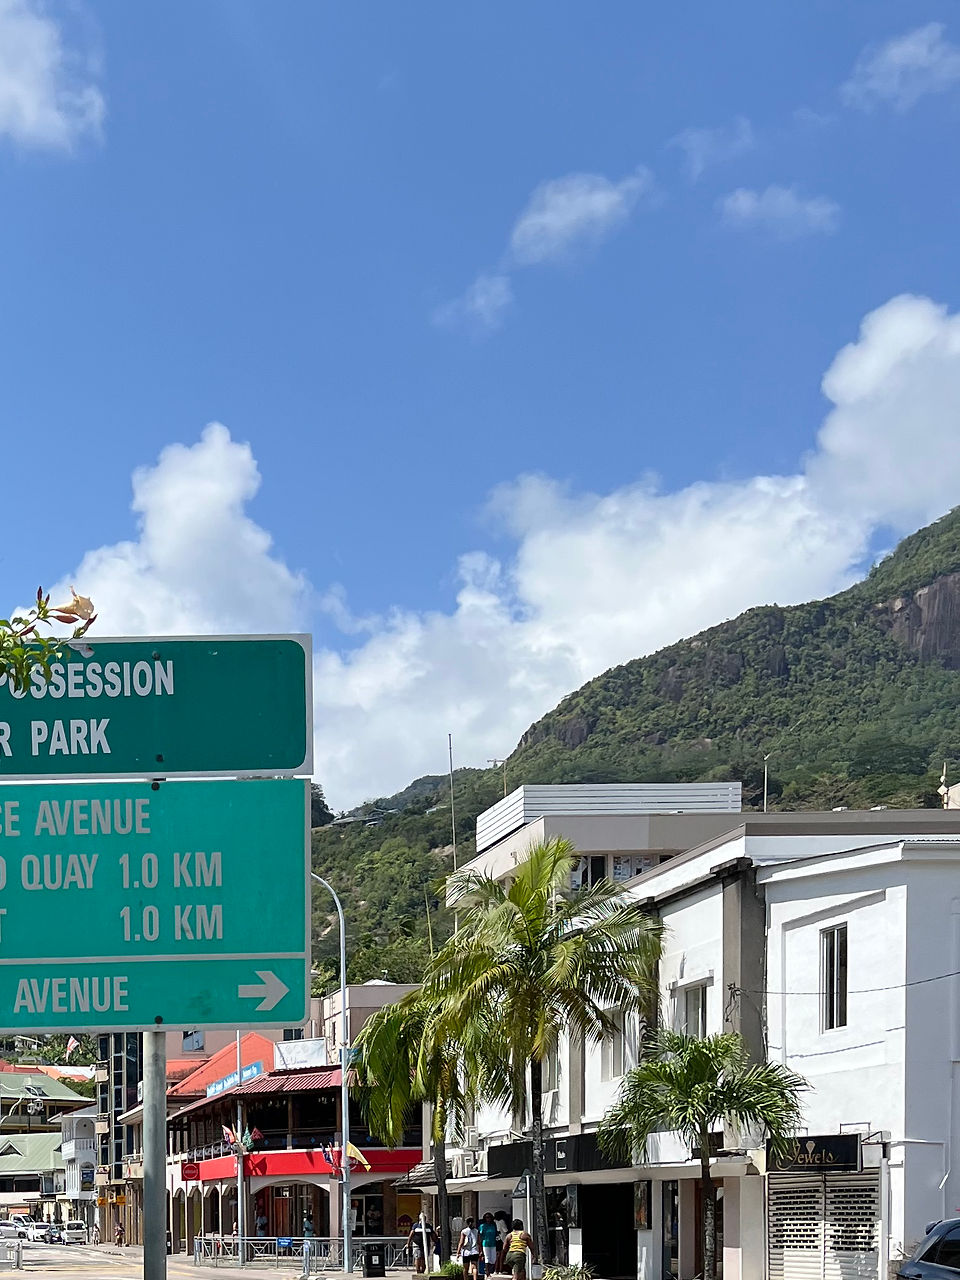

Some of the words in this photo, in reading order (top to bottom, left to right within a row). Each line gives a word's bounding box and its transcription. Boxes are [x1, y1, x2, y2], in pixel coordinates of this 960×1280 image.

[31, 719, 111, 755] PARK
[35, 799, 150, 834] AVENUE
[22, 854, 98, 890] QUAY
[119, 854, 158, 888] 1.0
[174, 852, 222, 887] KM
[121, 906, 159, 940] 1.0
[175, 905, 222, 940] KM
[14, 977, 128, 1012] AVENUE
